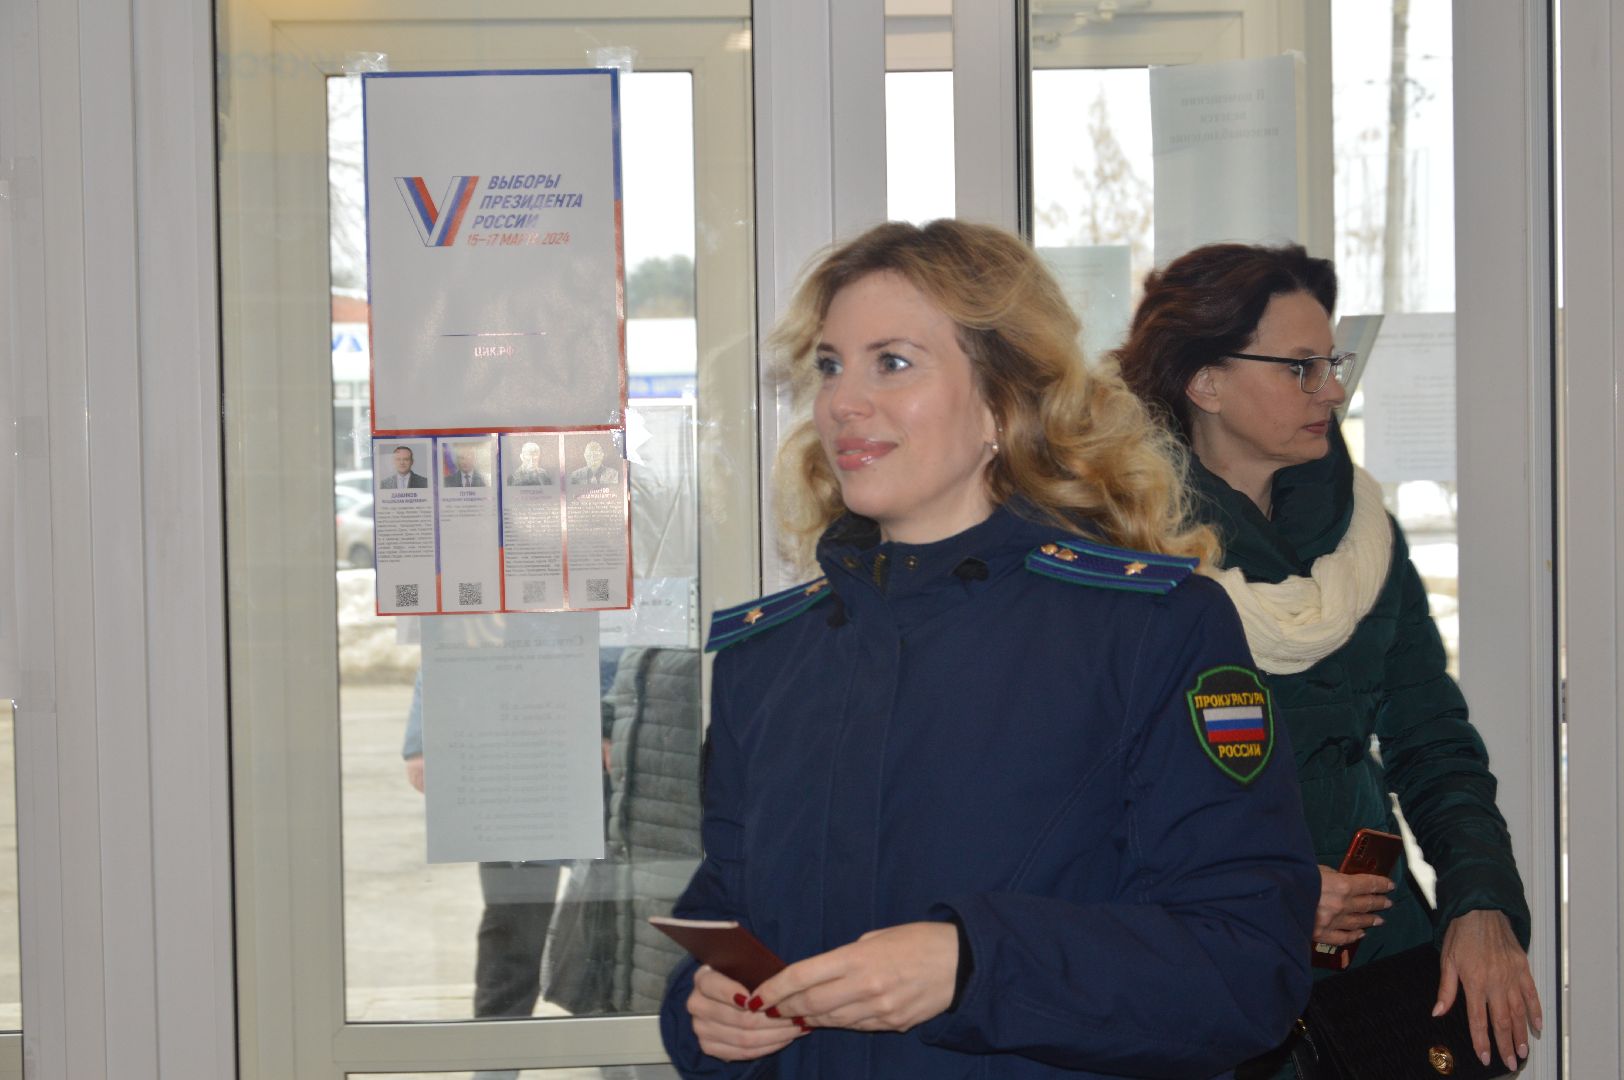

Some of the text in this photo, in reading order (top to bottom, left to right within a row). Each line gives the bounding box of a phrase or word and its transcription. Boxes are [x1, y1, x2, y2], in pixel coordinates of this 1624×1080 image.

[488, 174, 561, 190] ВЫБОРЫ
[479, 193, 584, 210] ПРЕЗИДЕНТА
[472, 214, 540, 229] РОССИИ
[541, 232, 571, 246] 2024
[1194, 692, 1265, 709] ПРОКУРАТУРА
[1218, 743, 1262, 758] РОССИИ
